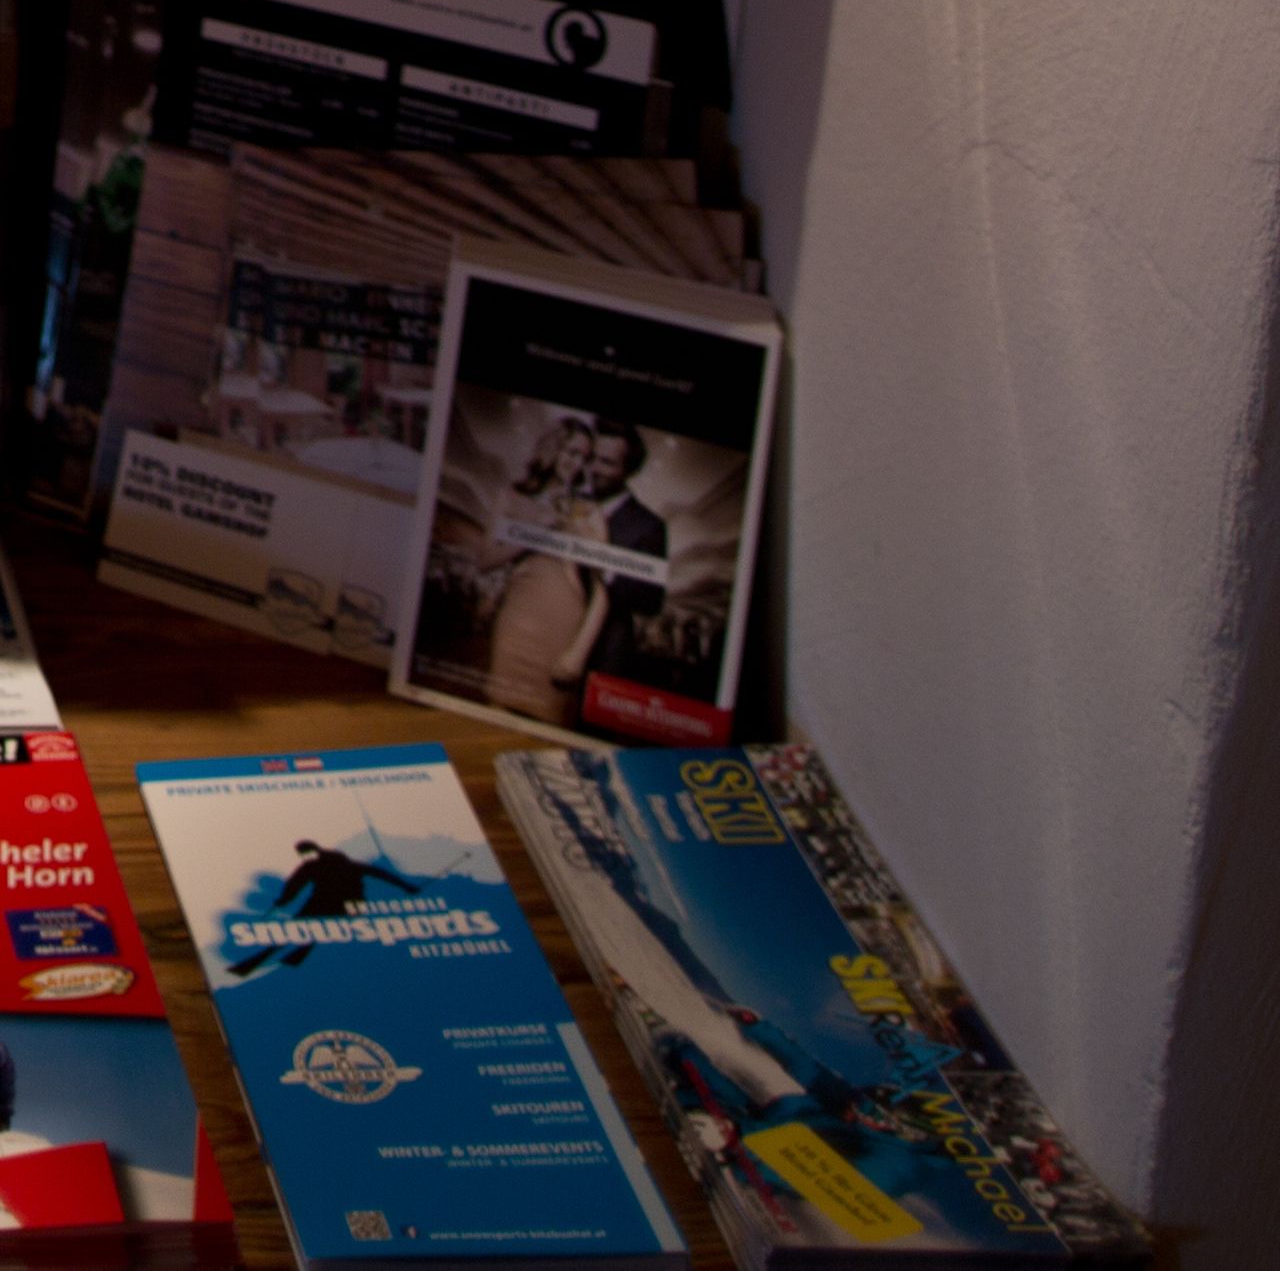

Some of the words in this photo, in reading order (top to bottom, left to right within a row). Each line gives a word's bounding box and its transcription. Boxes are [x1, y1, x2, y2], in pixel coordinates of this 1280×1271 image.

[165, 780, 233, 798] PRIVATE
[5, 864, 97, 891] Horn
[230, 906, 502, 947] snowsports
[409, 937, 513, 960] KITZBÜHEL
[442, 1020, 549, 1040] PRIVATKURSE
[477, 1059, 567, 1078] FREERIDEN
[490, 1099, 586, 1119] SKITOUREN
[376, 1142, 448, 1160] WINTER-
[471, 1138, 605, 1157] SOMMEREVENTS
